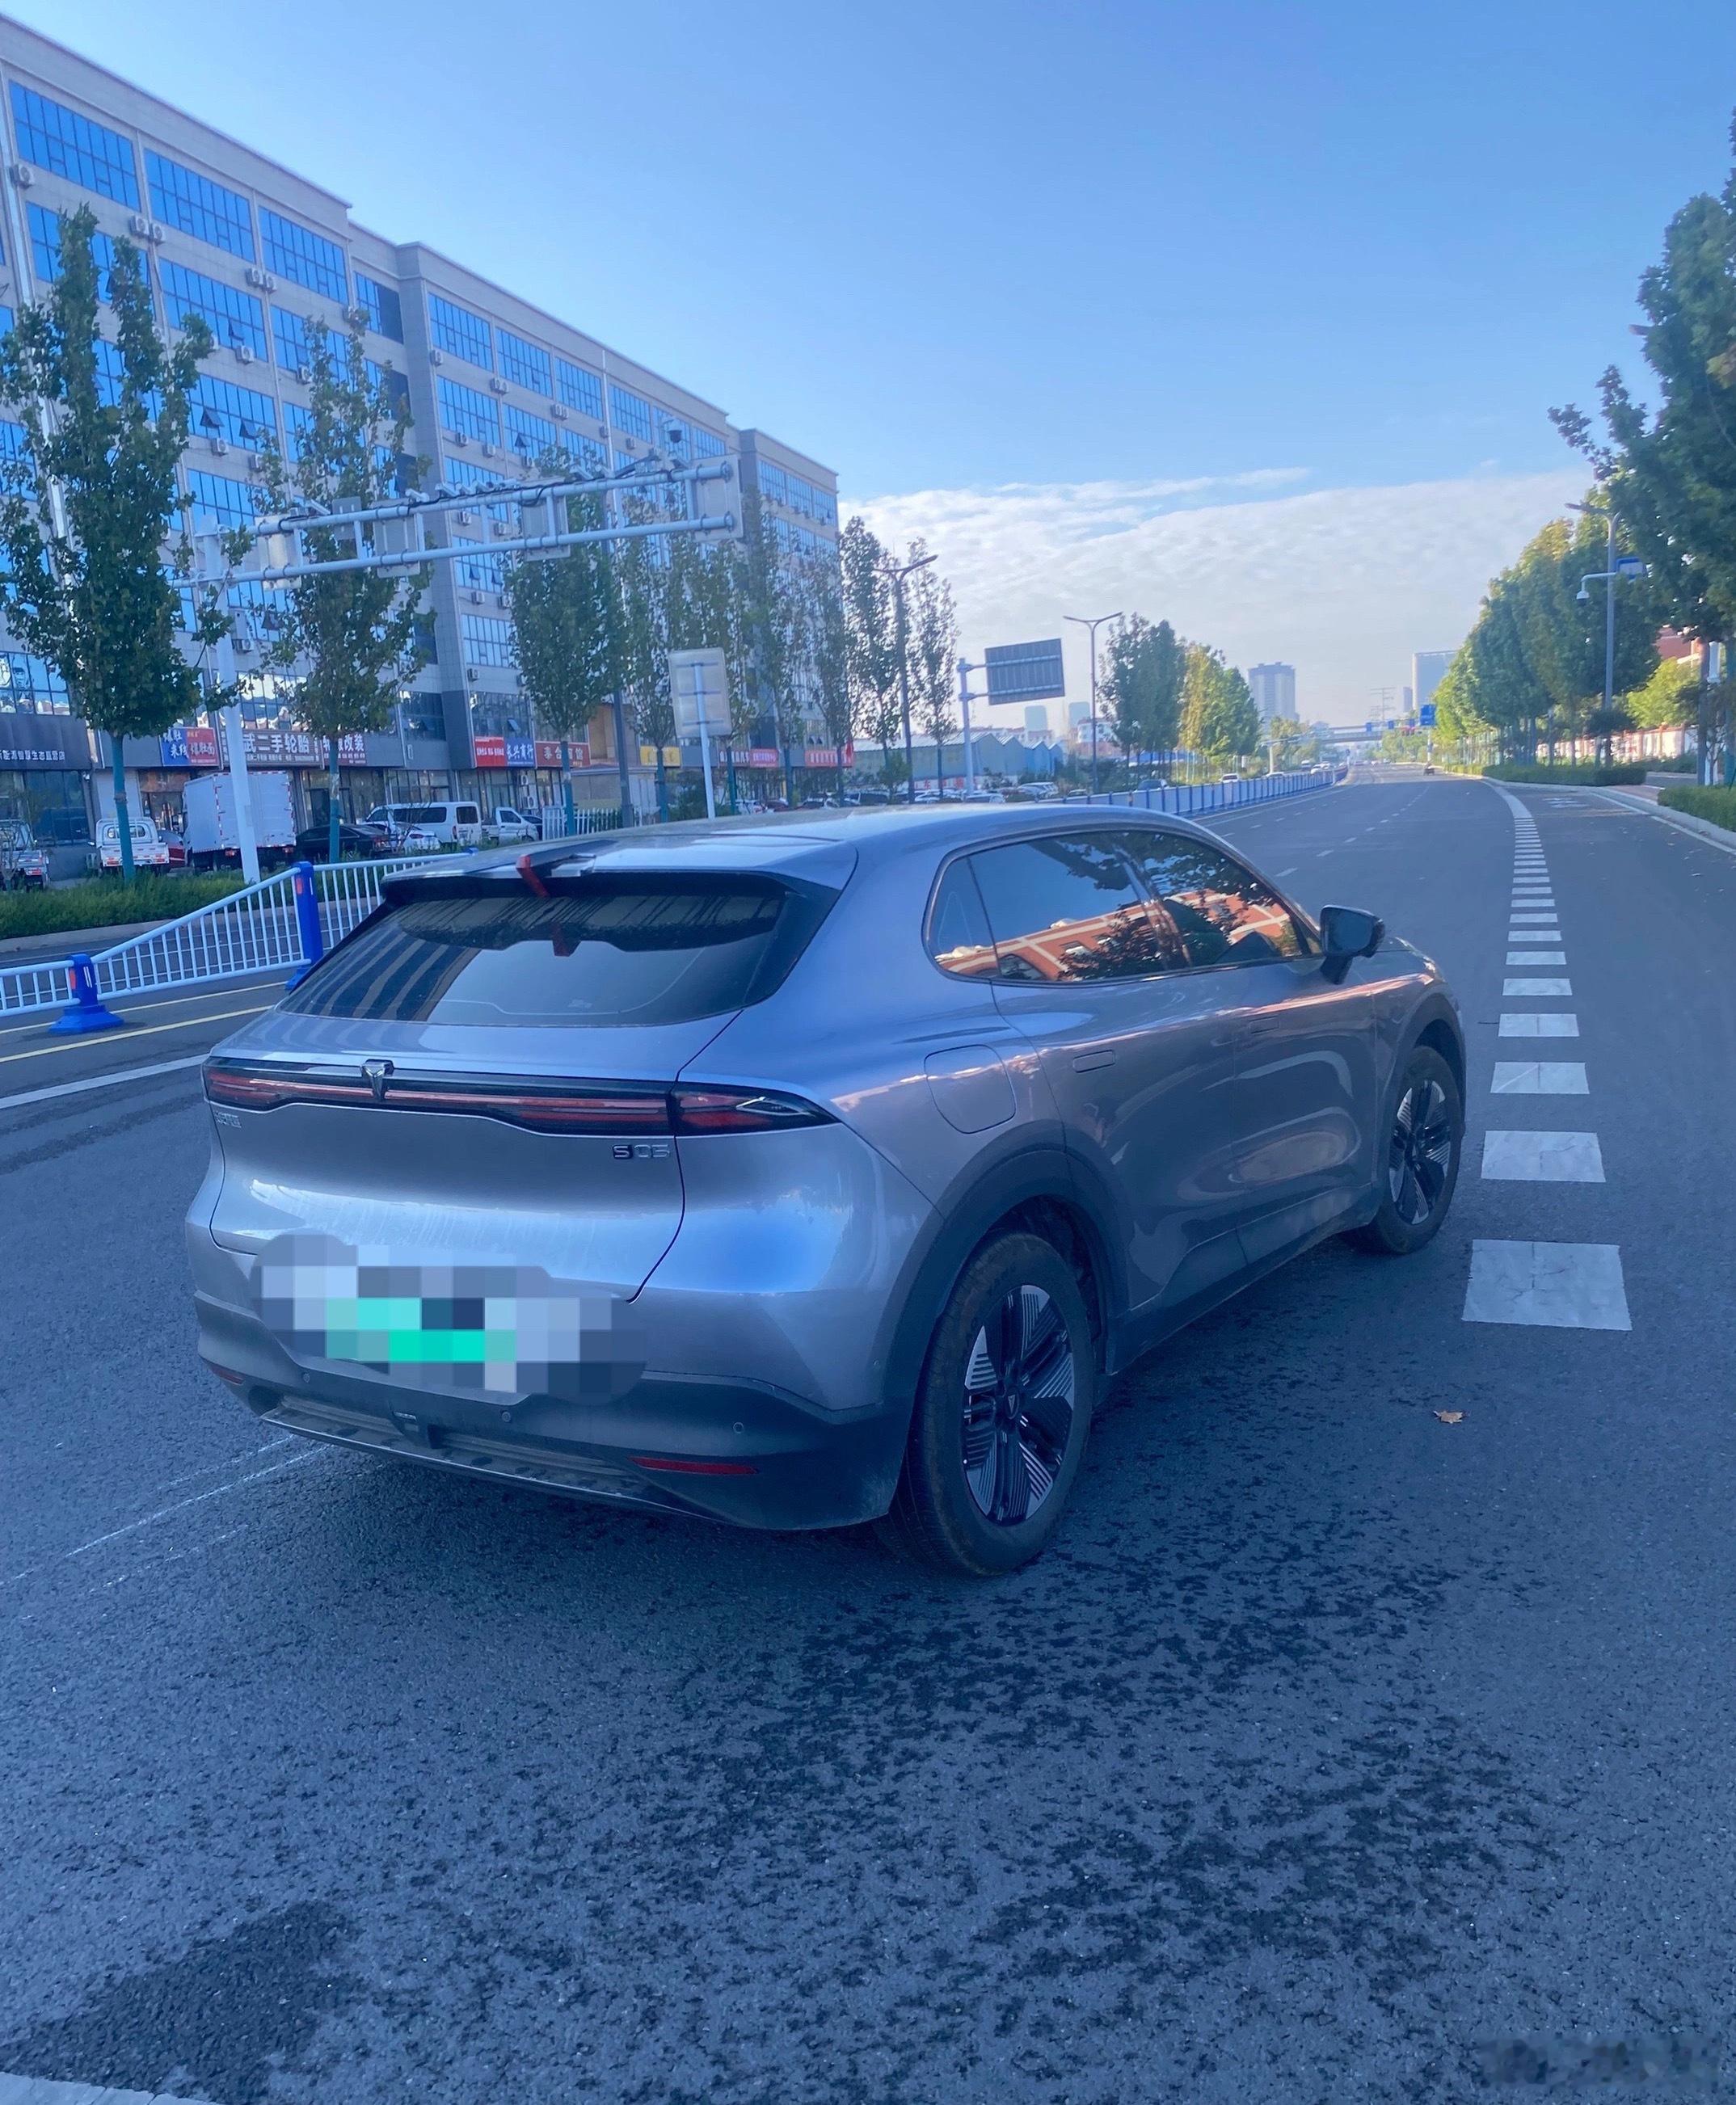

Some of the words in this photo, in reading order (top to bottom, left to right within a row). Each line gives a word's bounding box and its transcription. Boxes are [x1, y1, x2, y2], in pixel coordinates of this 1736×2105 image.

[242, 732, 311, 753] 武二手轮胎
